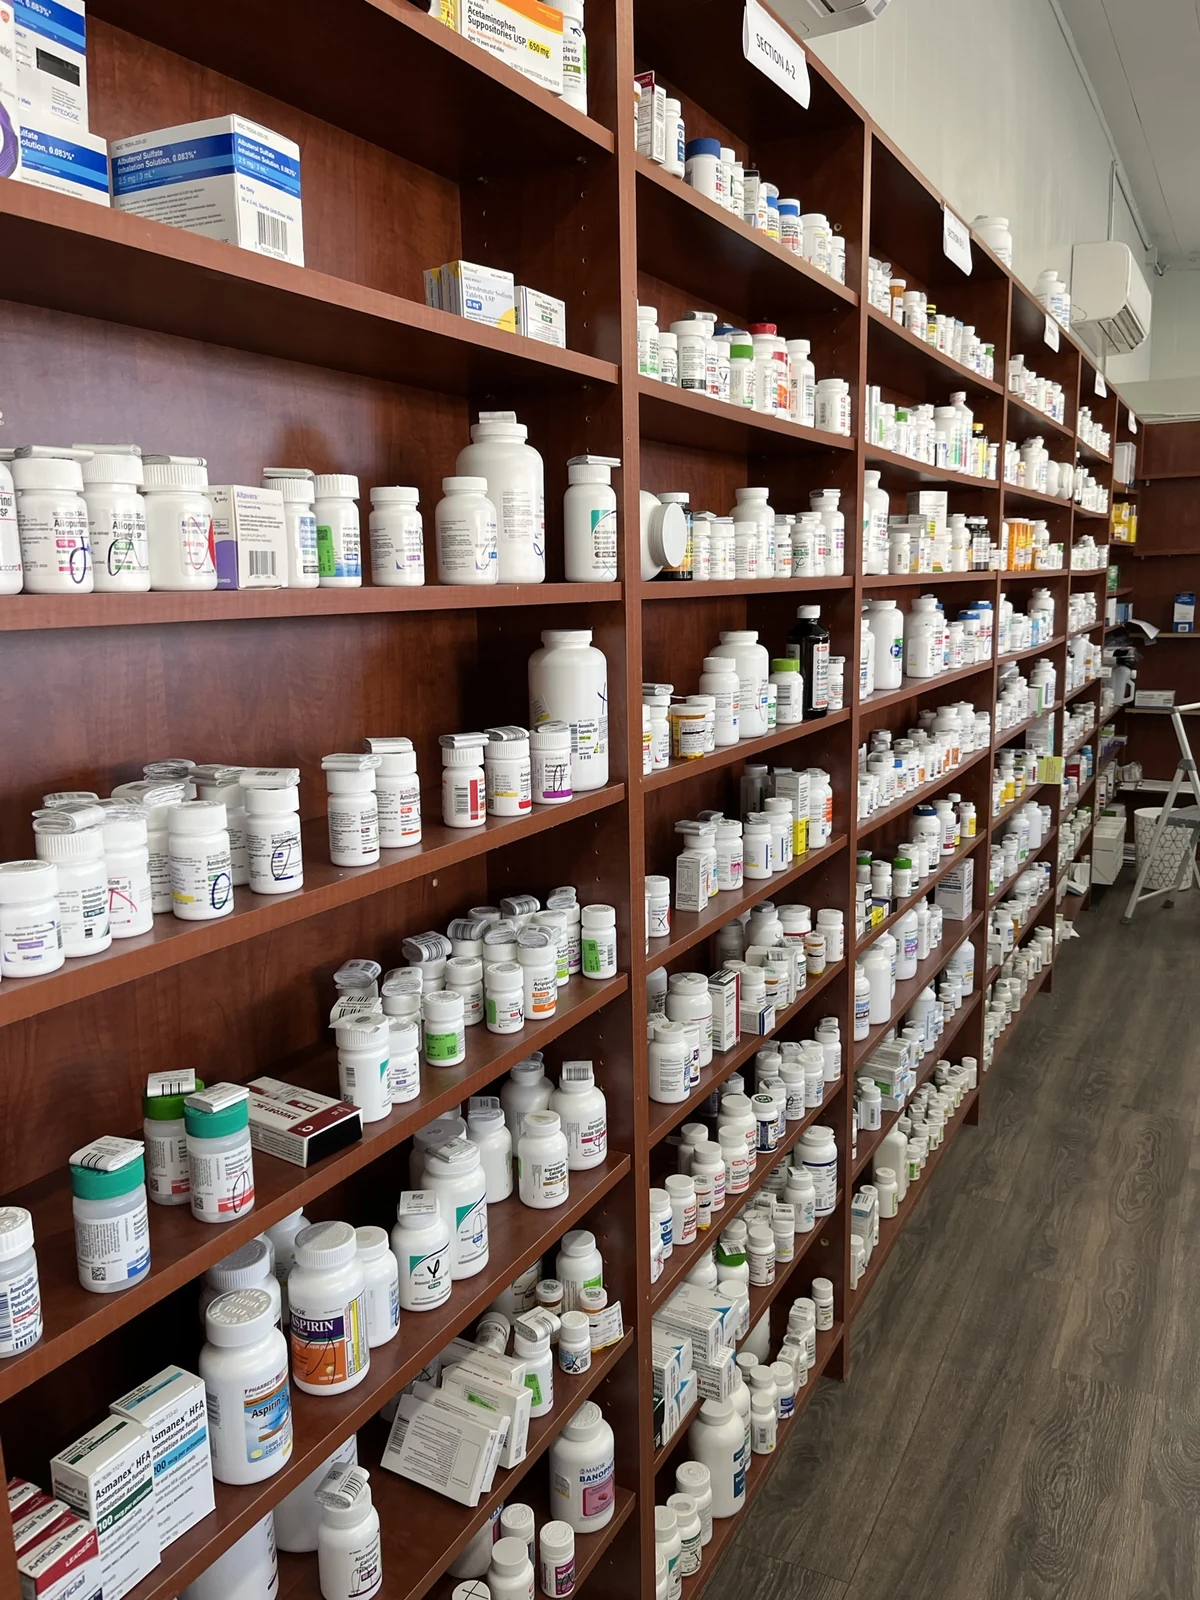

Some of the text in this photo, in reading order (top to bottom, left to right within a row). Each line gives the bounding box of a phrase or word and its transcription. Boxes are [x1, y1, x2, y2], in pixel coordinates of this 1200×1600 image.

[467, 6, 516, 32] Acetaminophen
[467, 16, 550, 59] Suppositories USP, 650 mg
[562, 46, 577, 54] clovir
[756, 33, 796, 80] SECTION A-2
[117, 149, 163, 166] Albuterol Sulfate
[238, 138, 275, 160] Albuterol Sulfate
[238, 146, 261, 161] Inhalation
[117, 161, 145, 174] Inhalation
[145, 156, 172, 168] Solution,
[495, 290, 513, 300] Sodium
[10, 1277, 34, 1294] Amoxicillin
[10, 1292, 20, 1301] and
[11, 1293, 34, 1309] Potassium
[12, 1305, 30, 1316] Tablets,
[291, 1314, 334, 1332] ASPIRIN
[249, 1378, 275, 1393] PHARBEST
[189, 1400, 205, 1417] HFA
[251, 1399, 281, 1419] Aspirin
[179, 1423, 199, 1441] Aerosol
[136, 1450, 151, 1468] HFA
[167, 1455, 177, 1466] mcg
[586, 1463, 605, 1474] MAJOR
[96, 1479, 131, 1509] (mometasone
[131, 1461, 151, 1482] furoate)
[96, 1475, 146, 1518] Inhalation Aerosol
[36, 1504, 59, 1519] Tears
[98, 1515, 113, 1533] 100
[114, 1509, 124, 1522] mcg
[28, 1524, 84, 1572] Artificial Tears
